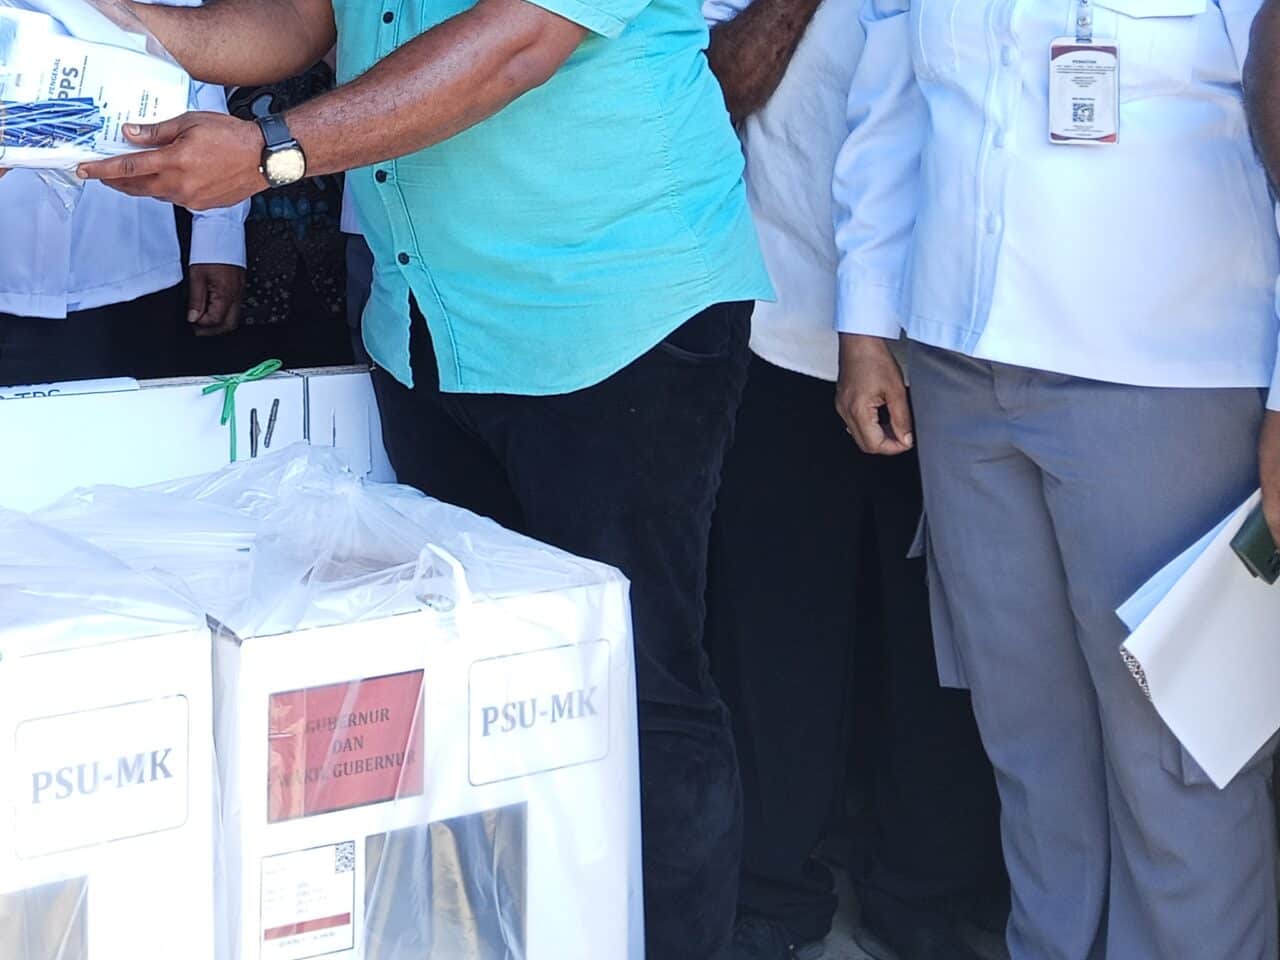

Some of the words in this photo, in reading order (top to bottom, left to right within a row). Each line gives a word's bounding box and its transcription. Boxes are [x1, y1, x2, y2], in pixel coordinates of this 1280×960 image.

[481, 685, 599, 737] PSU-MK
[332, 735, 365, 755] DAN
[31, 747, 174, 805] PSU-MK
